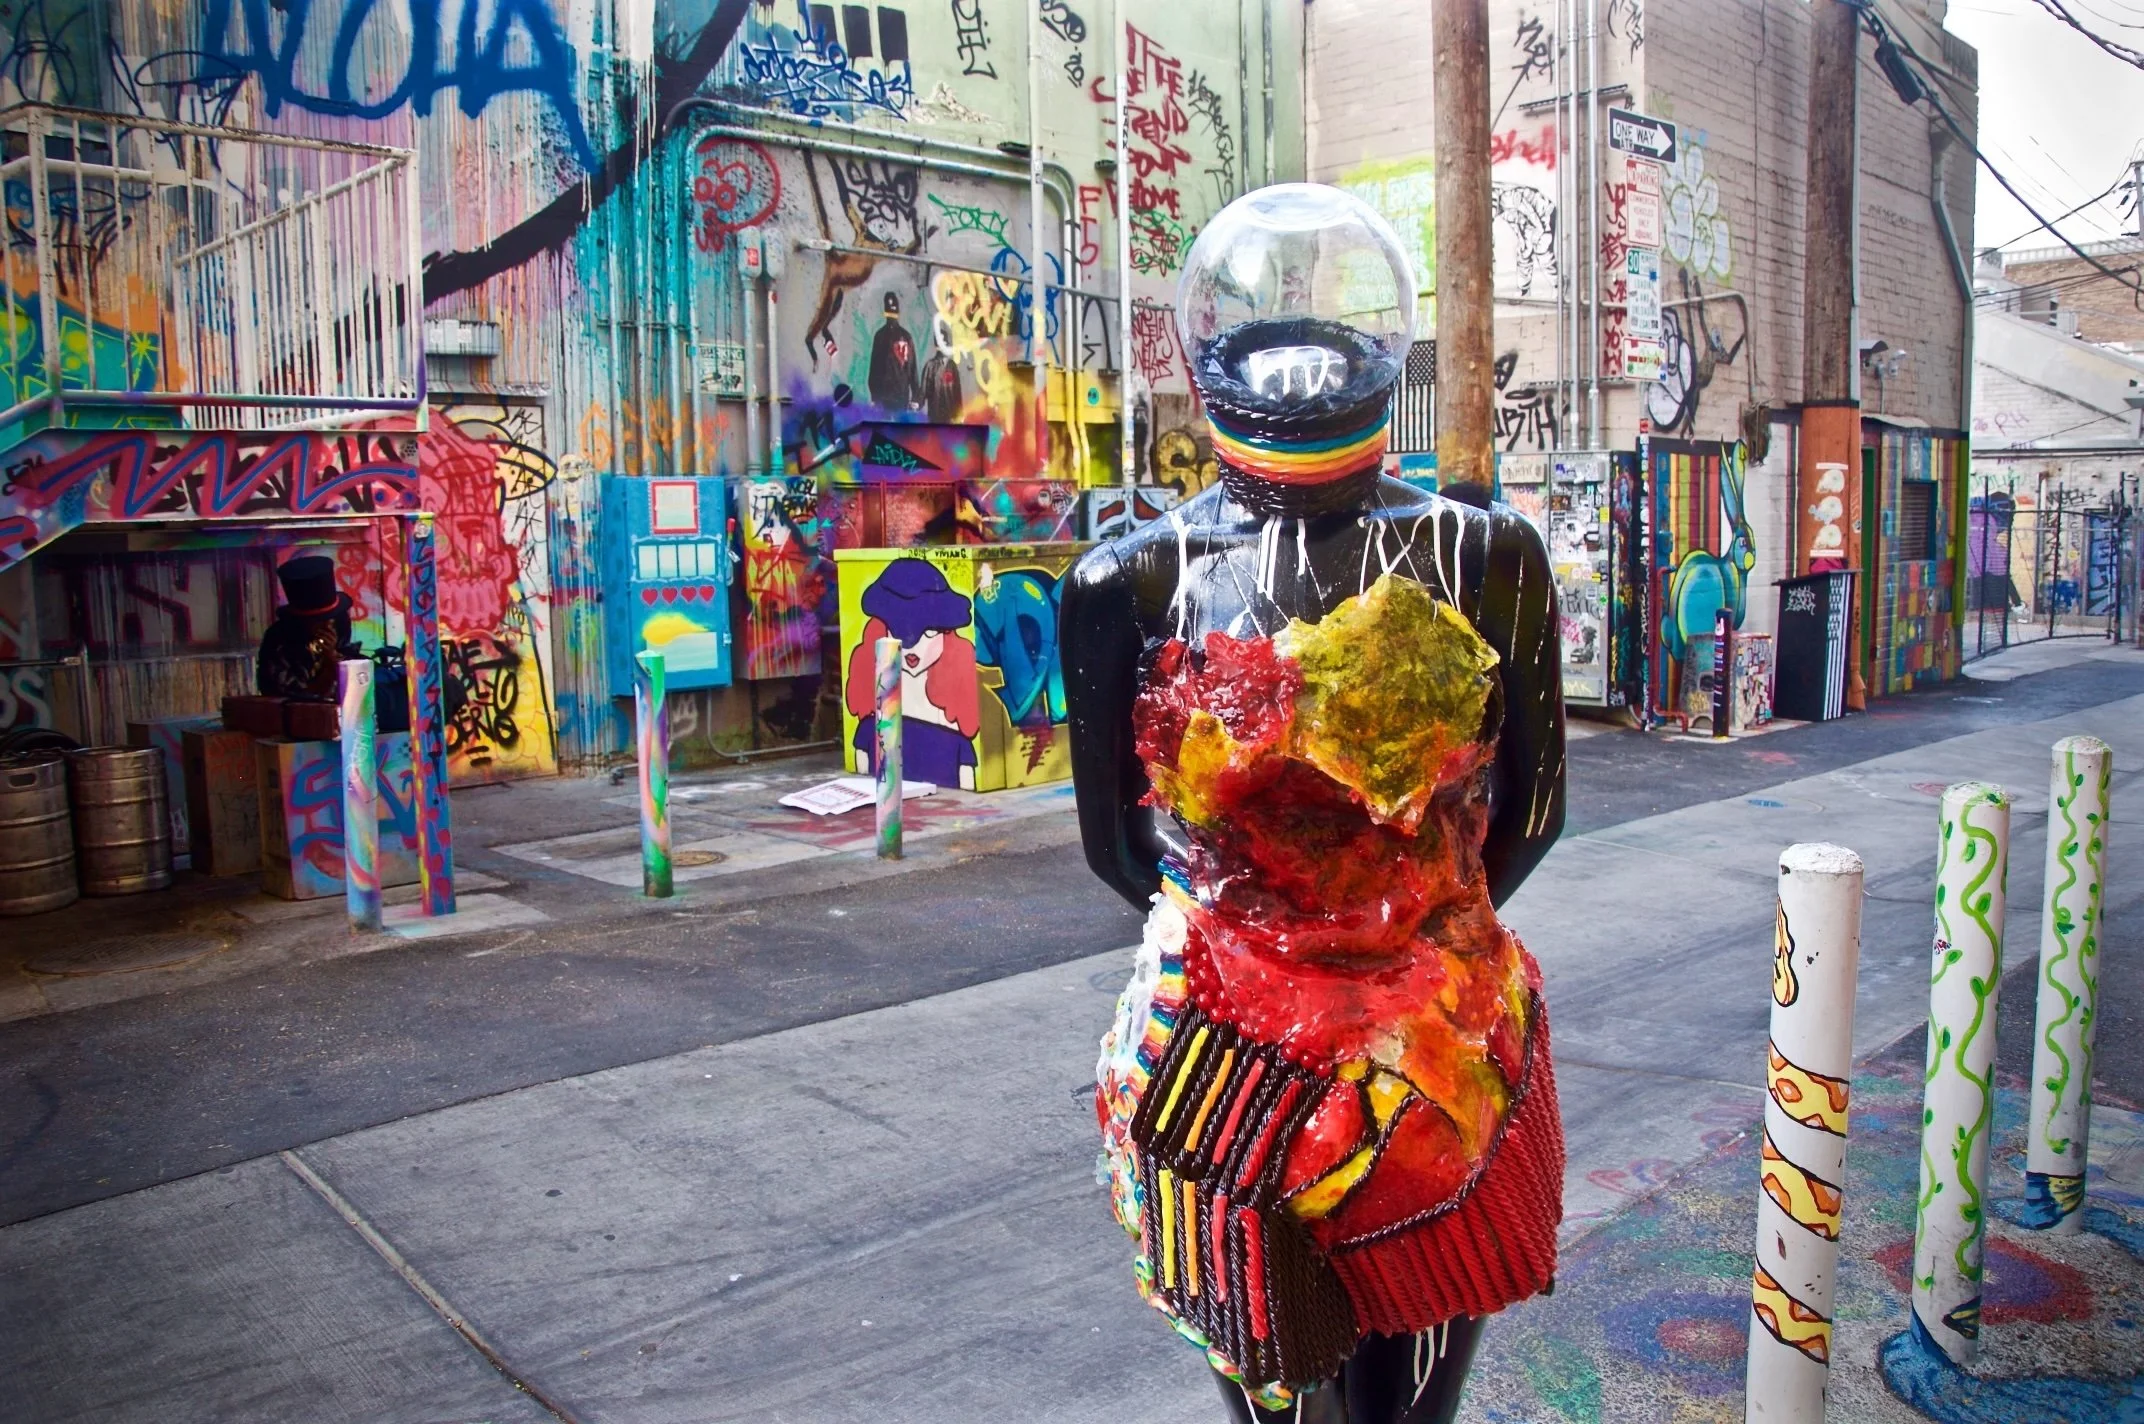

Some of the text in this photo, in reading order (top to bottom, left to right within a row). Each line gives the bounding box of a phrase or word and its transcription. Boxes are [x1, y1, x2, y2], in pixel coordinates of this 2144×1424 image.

[1615, 122, 1655, 146] ONE WAY
[1628, 251, 1639, 273] 30
